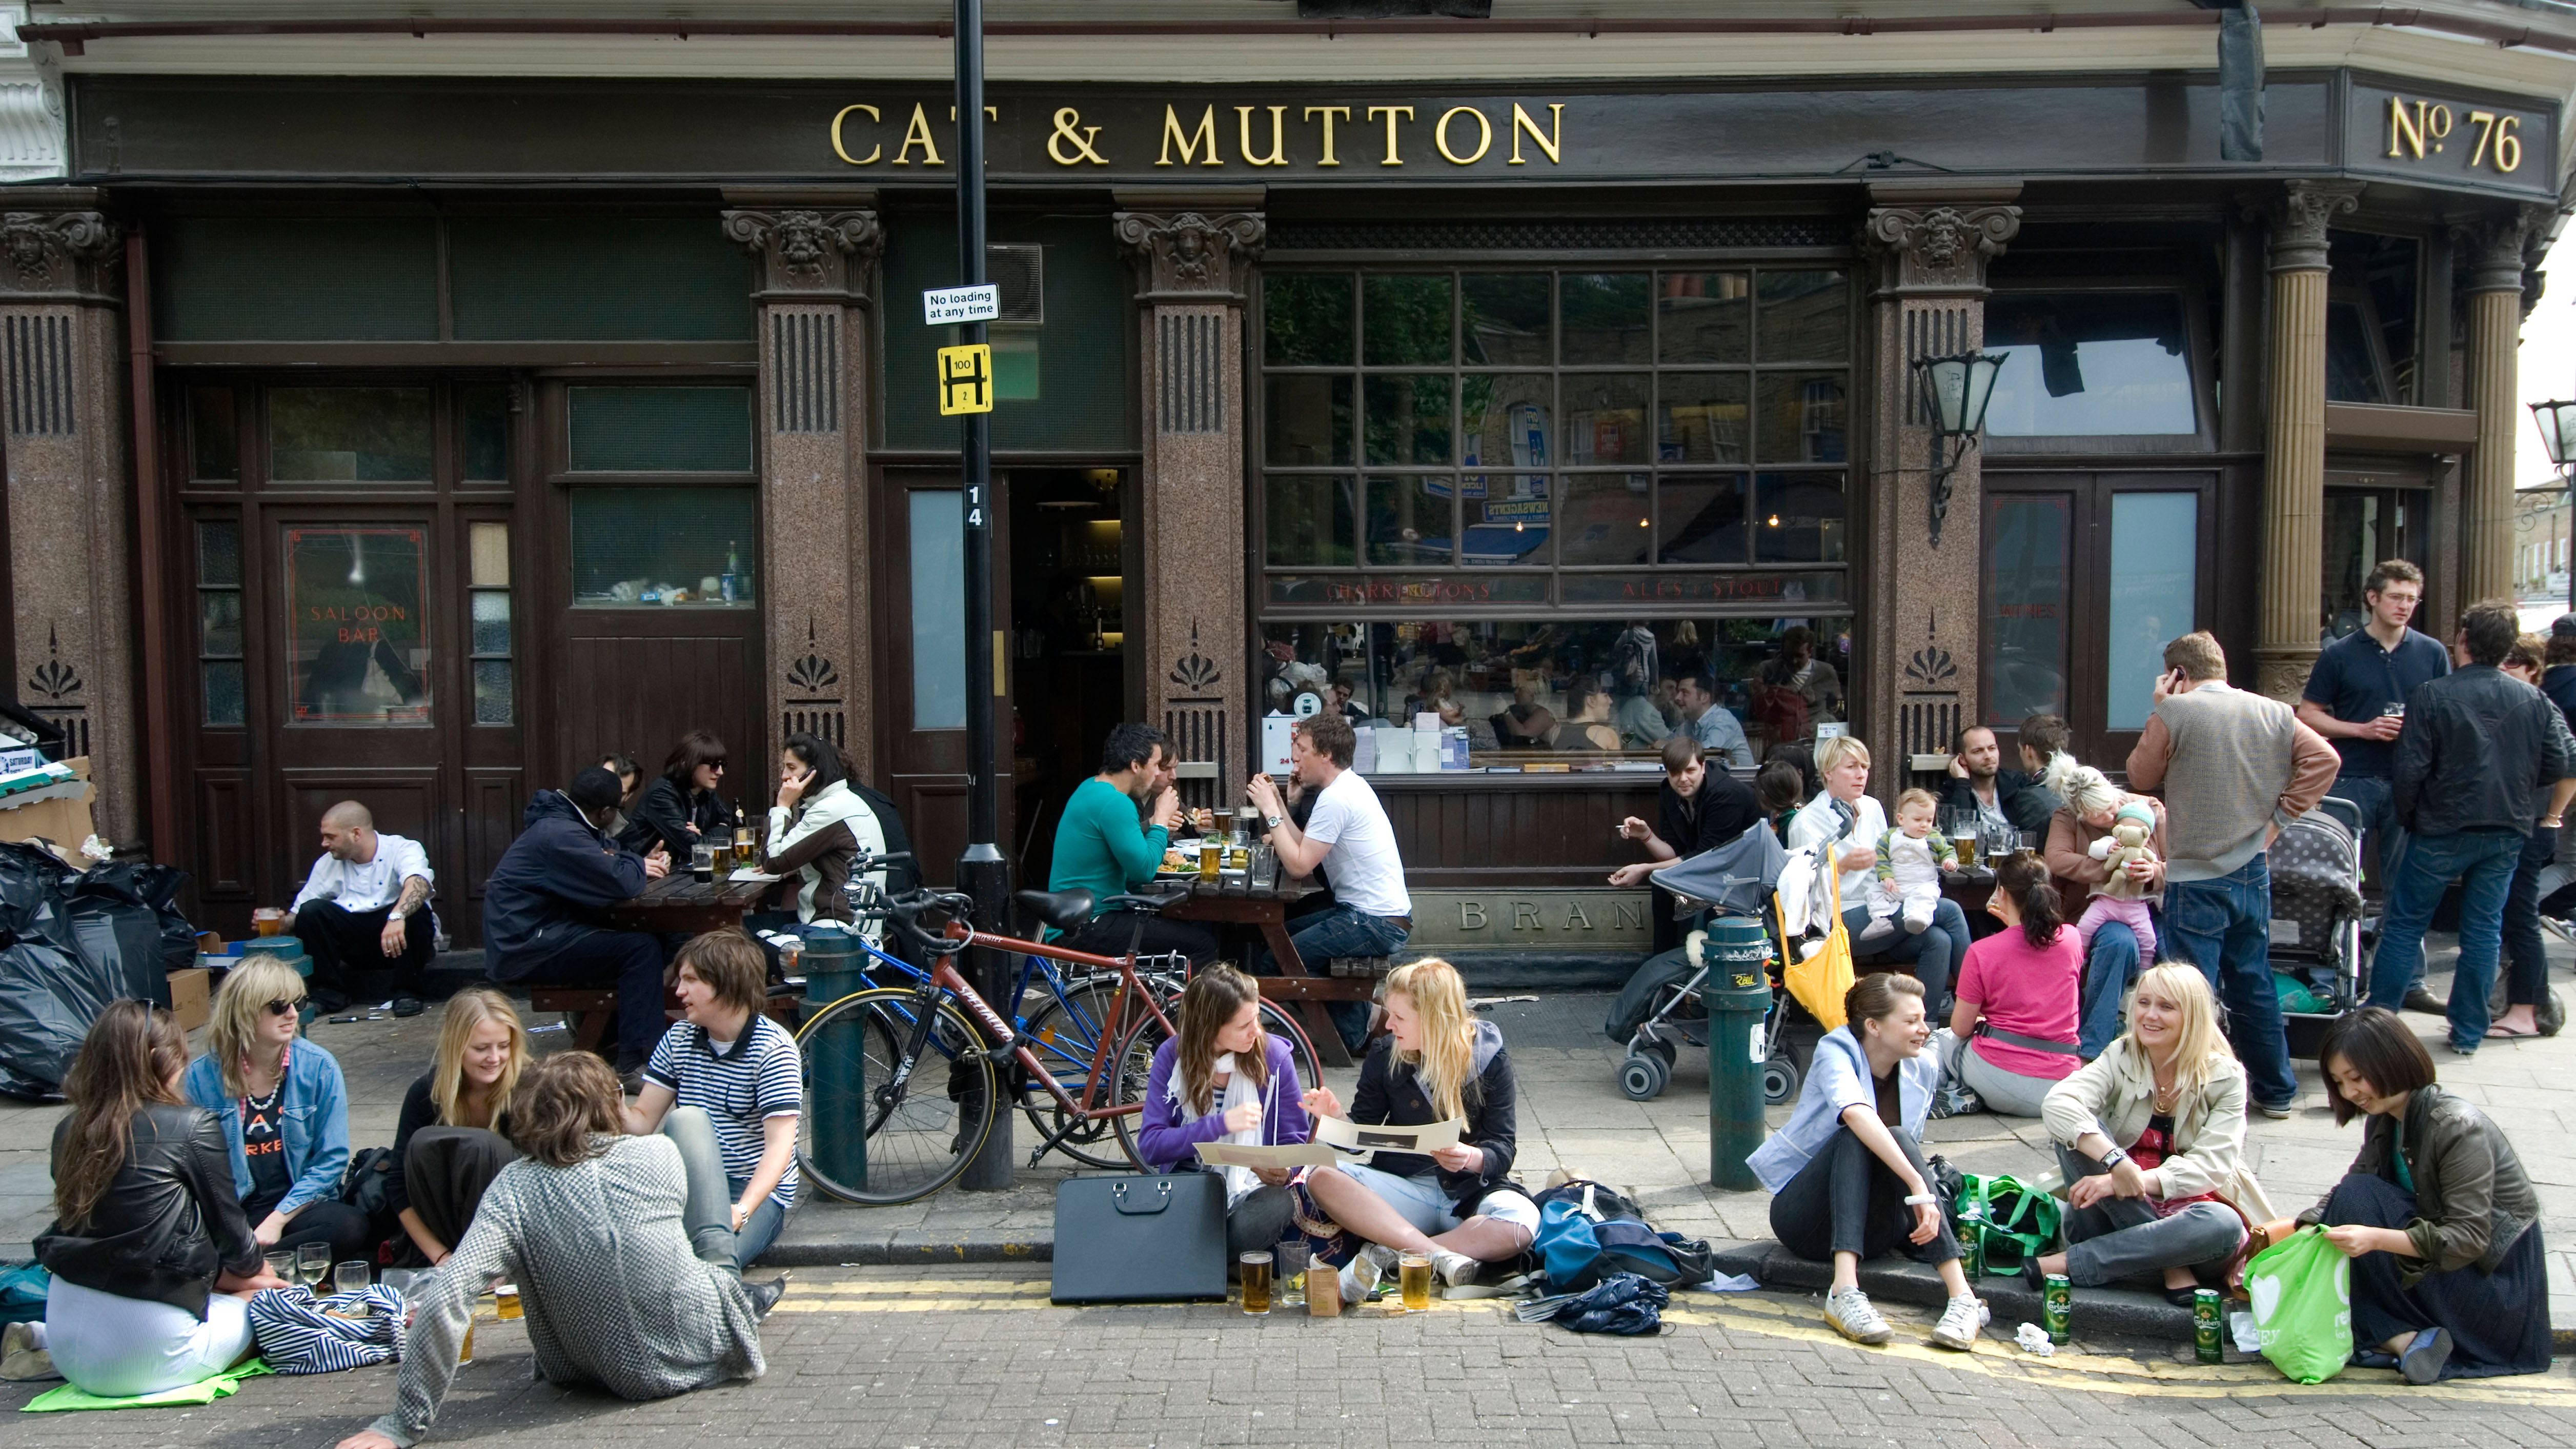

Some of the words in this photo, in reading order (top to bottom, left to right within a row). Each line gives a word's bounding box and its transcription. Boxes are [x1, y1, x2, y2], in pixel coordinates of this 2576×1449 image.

[1047, 107, 1109, 166] &
[1154, 103, 1565, 167] MUTTON
[2470, 110, 2521, 172] 76
[930, 294, 946, 305] No
[950, 291, 991, 305] loading
[930, 309, 941, 318] at
[945, 307, 964, 318] any
[968, 304, 993, 315] time
[955, 360, 970, 370] 100
[962, 391, 967, 401] 2
[1327, 582, 1489, 598] CHARRINGTONS
[1623, 581, 1682, 597] ALES
[1713, 580, 1782, 595] STOUT
[311, 607, 404, 621] SALOON
[1999, 603, 2056, 619] WINES
[338, 628, 378, 642] BAR
[9, 756, 33, 767] SATURDAY
[2194, 1315, 2221, 1328] Carlsberg
